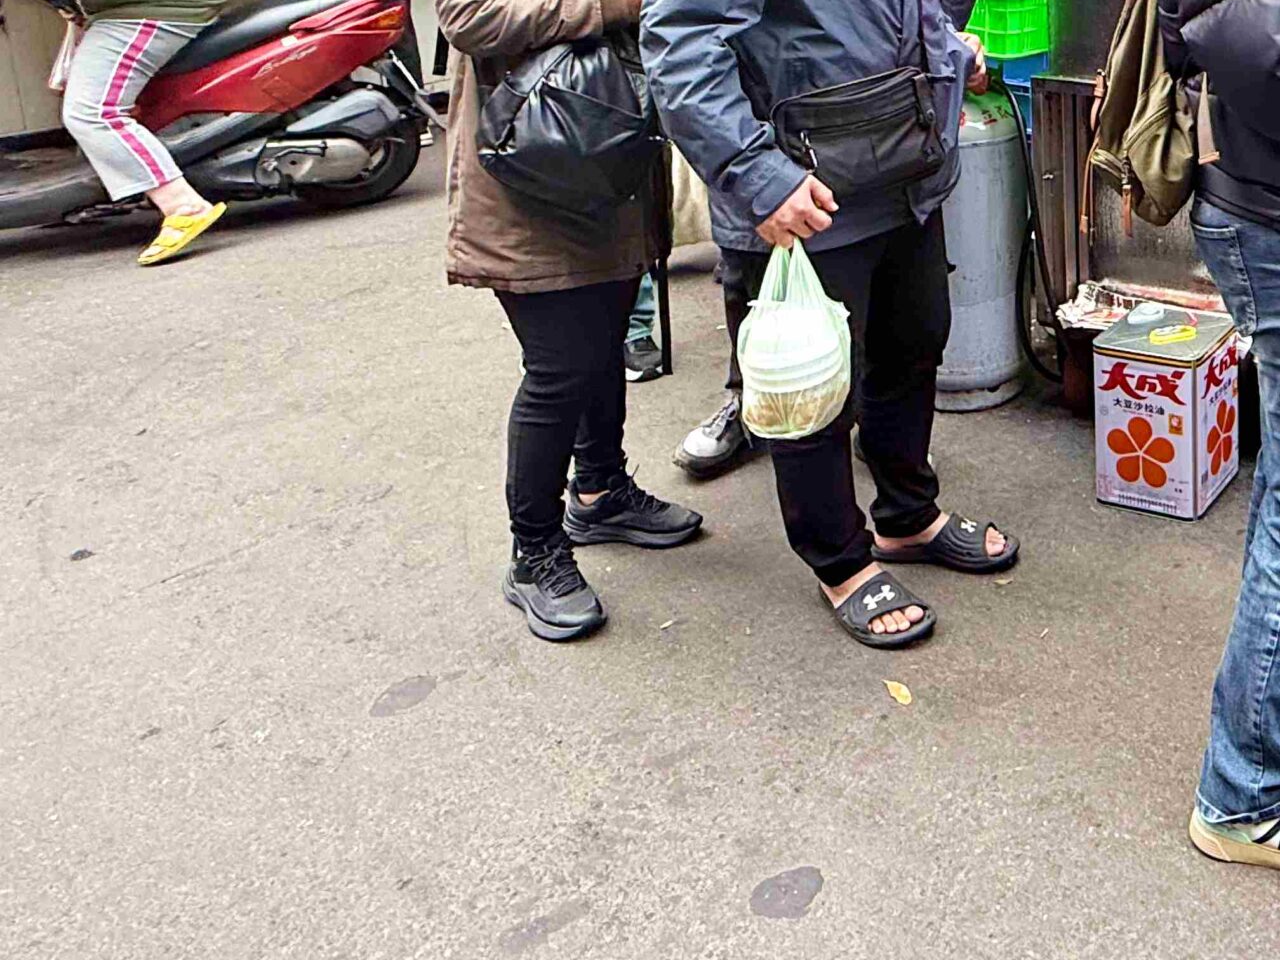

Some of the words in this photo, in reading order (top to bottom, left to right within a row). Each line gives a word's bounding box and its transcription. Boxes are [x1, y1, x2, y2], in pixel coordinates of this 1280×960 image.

[1098, 362, 1187, 406] 大成
[1113, 397, 1165, 416] 大豆沙拉油
